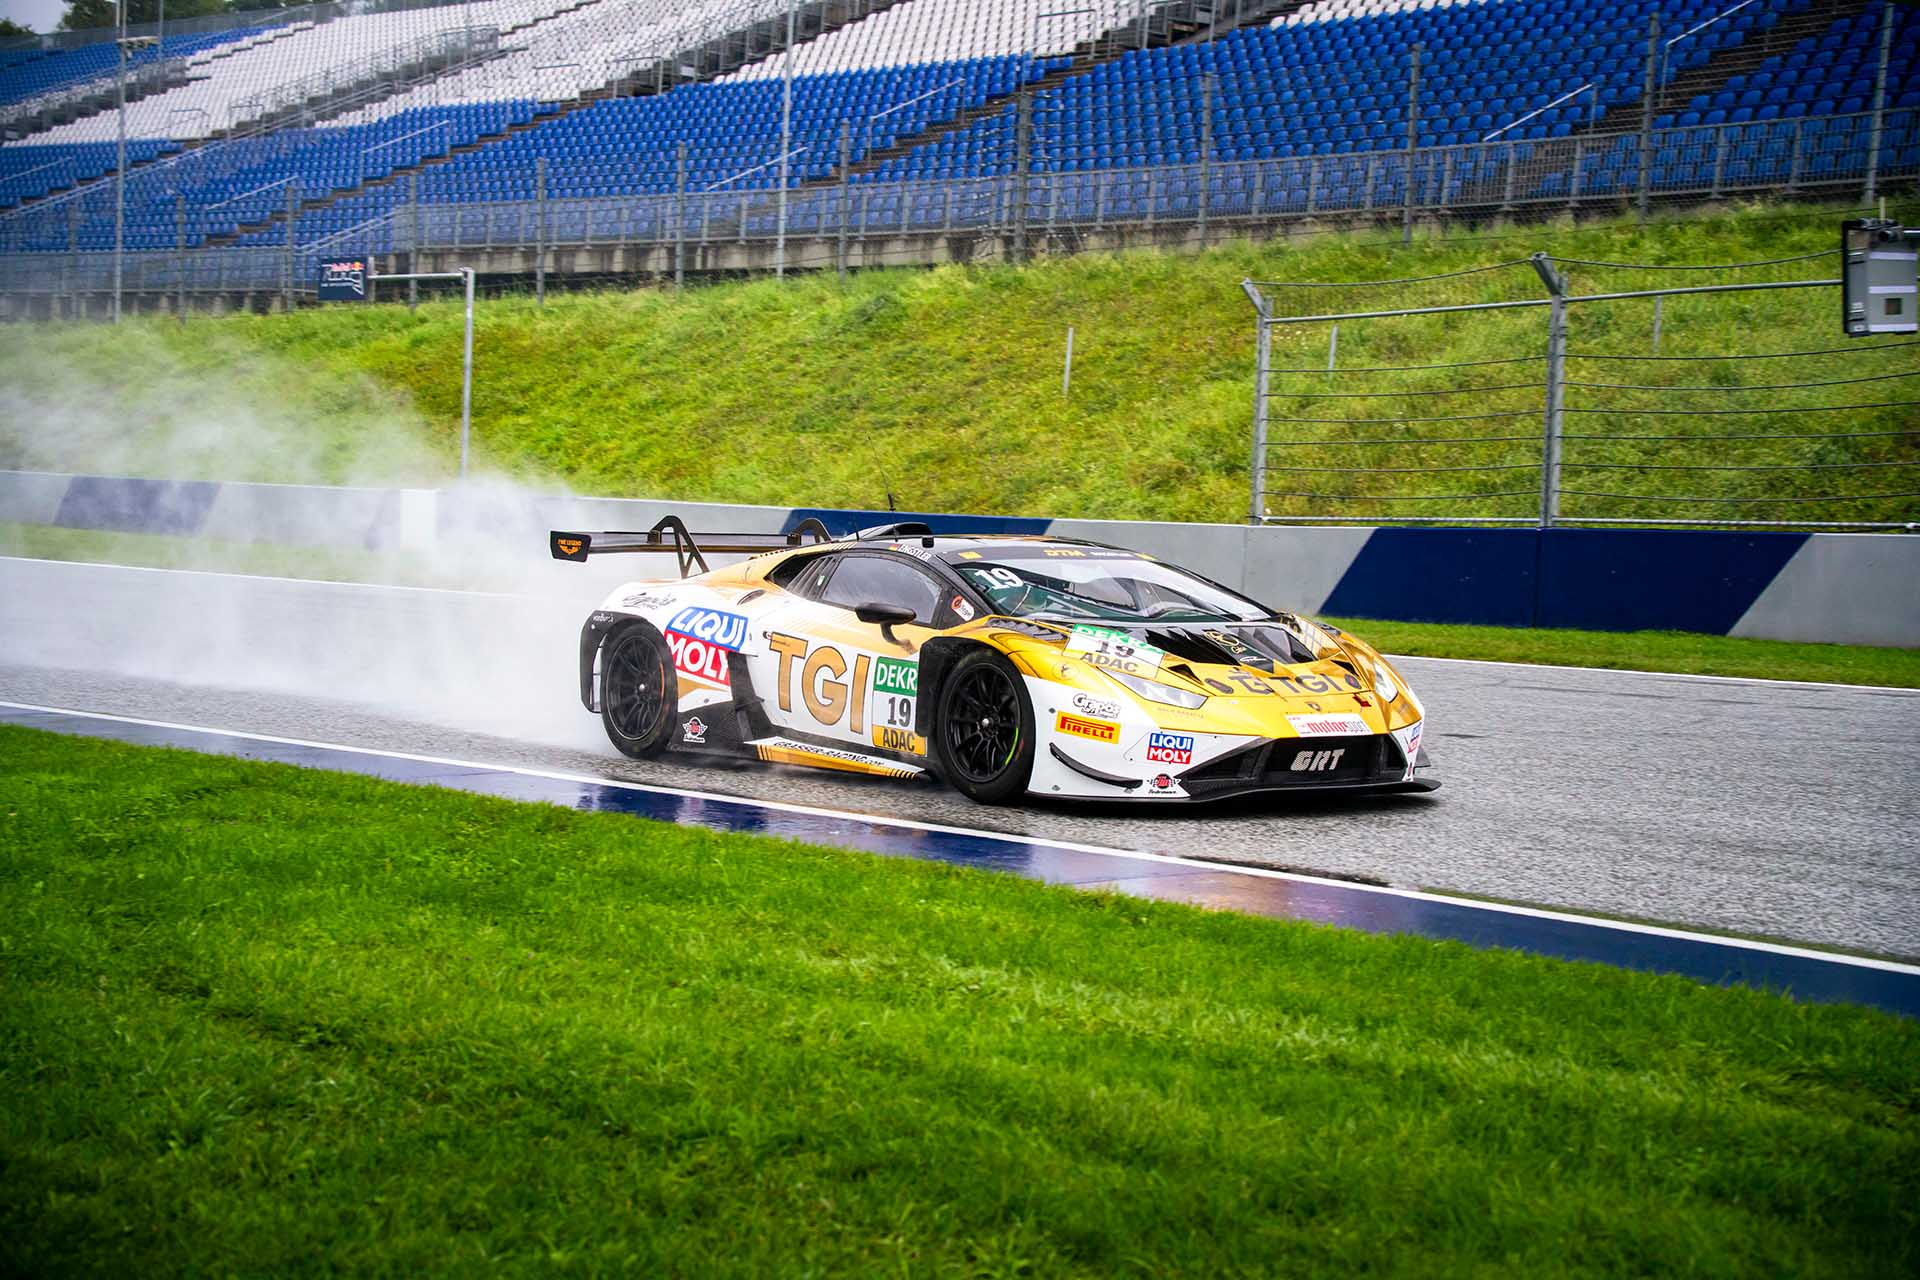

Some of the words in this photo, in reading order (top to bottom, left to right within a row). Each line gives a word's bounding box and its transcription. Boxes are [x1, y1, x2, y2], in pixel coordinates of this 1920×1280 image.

[974, 568, 1025, 590] 19
[670, 607, 746, 649] LIQUI
[666, 632, 729, 681] MOLY
[1095, 640, 1135, 658] 19
[1080, 651, 1138, 673] ADAC
[769, 631, 872, 736] TGI
[876, 662, 919, 691] DEKR
[1268, 672, 1344, 694] TGI
[887, 696, 912, 728] 19
[1060, 715, 1115, 740] PIRELLI
[883, 728, 915, 752] ADAC
[1151, 734, 1193, 751] LIQUI
[1149, 748, 1191, 764] MOLY
[1290, 748, 1346, 772] GRT
